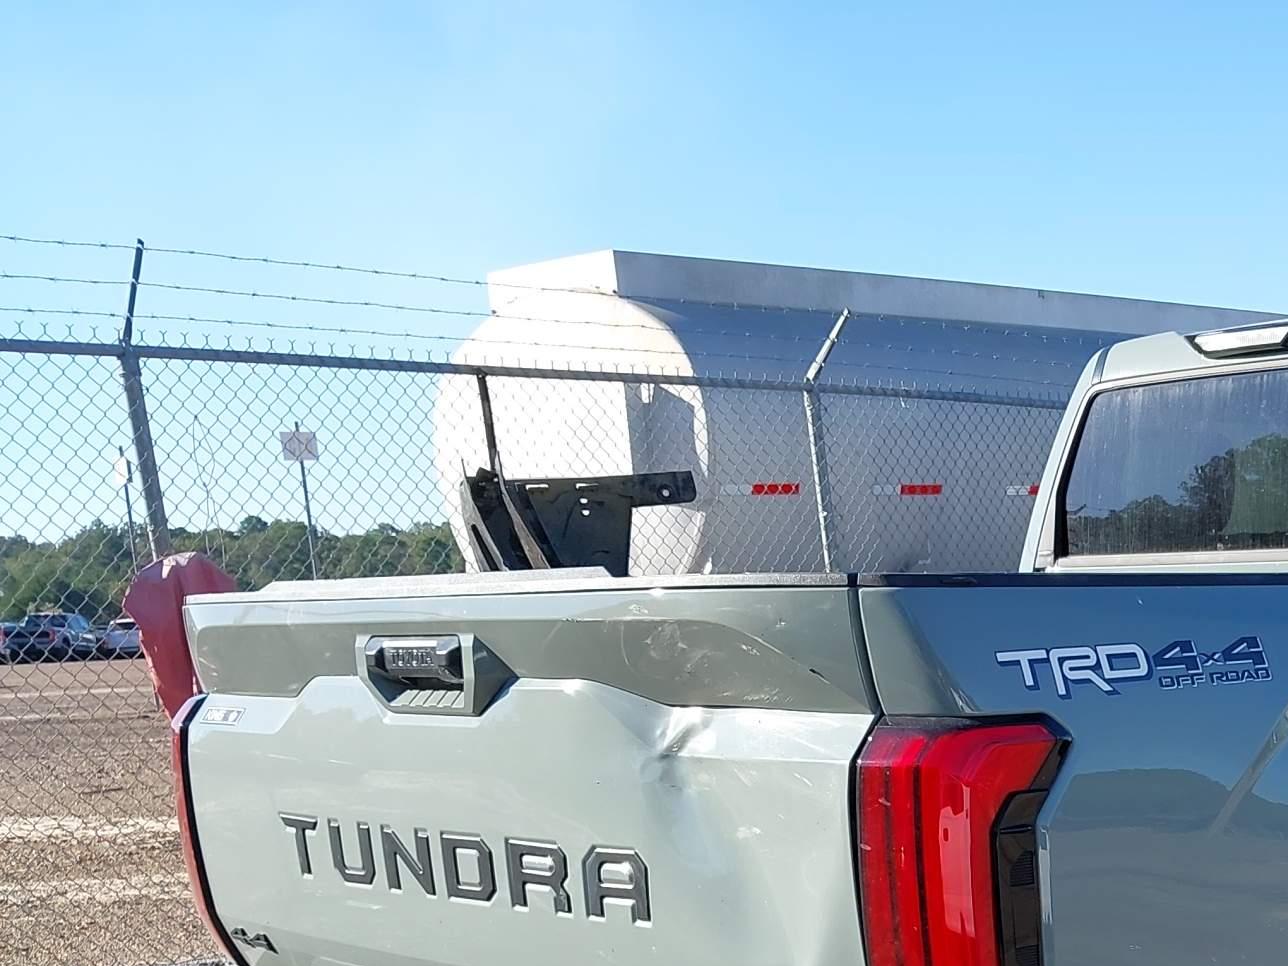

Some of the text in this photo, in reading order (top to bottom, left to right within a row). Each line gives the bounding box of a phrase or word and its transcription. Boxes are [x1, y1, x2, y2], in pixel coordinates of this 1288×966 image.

[390, 648, 435, 667] TOYOTA
[996, 636, 1268, 699] TRD 4x4
[1159, 669, 1273, 690] OFF ROAD
[278, 811, 653, 928] TUNDRA
